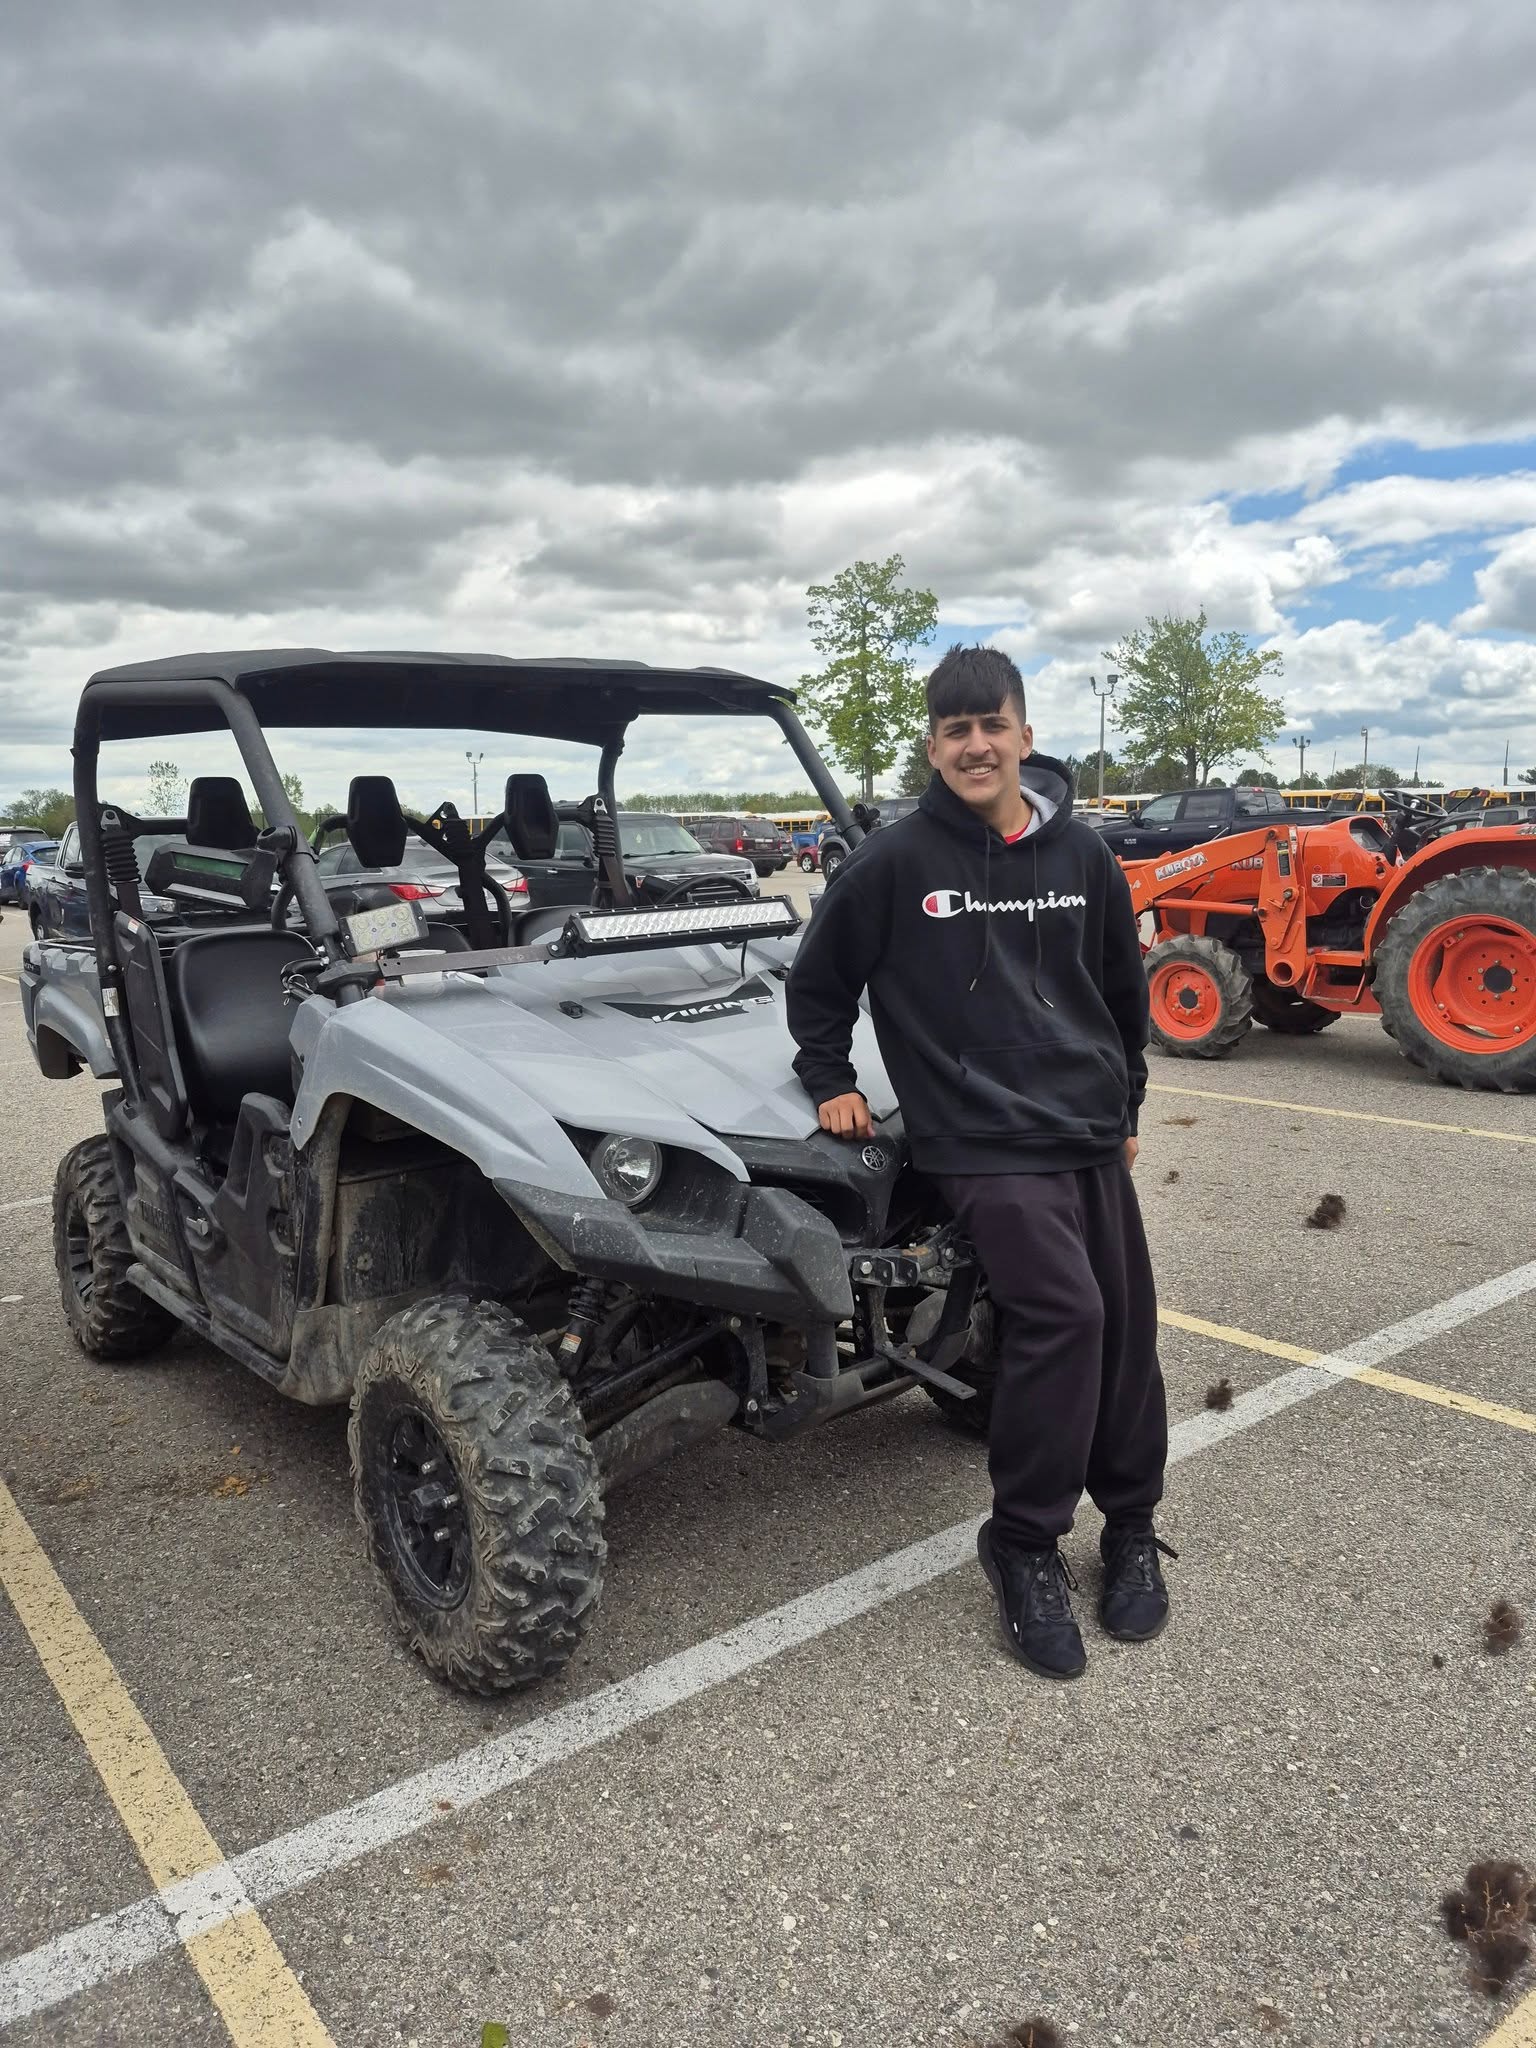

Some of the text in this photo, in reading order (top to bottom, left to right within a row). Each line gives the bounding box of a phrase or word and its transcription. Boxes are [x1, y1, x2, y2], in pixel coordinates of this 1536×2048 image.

[1155, 852, 1208, 881] KUBOTA
[1231, 857, 1264, 871] KUB
[922, 889, 1087, 922] Champion
